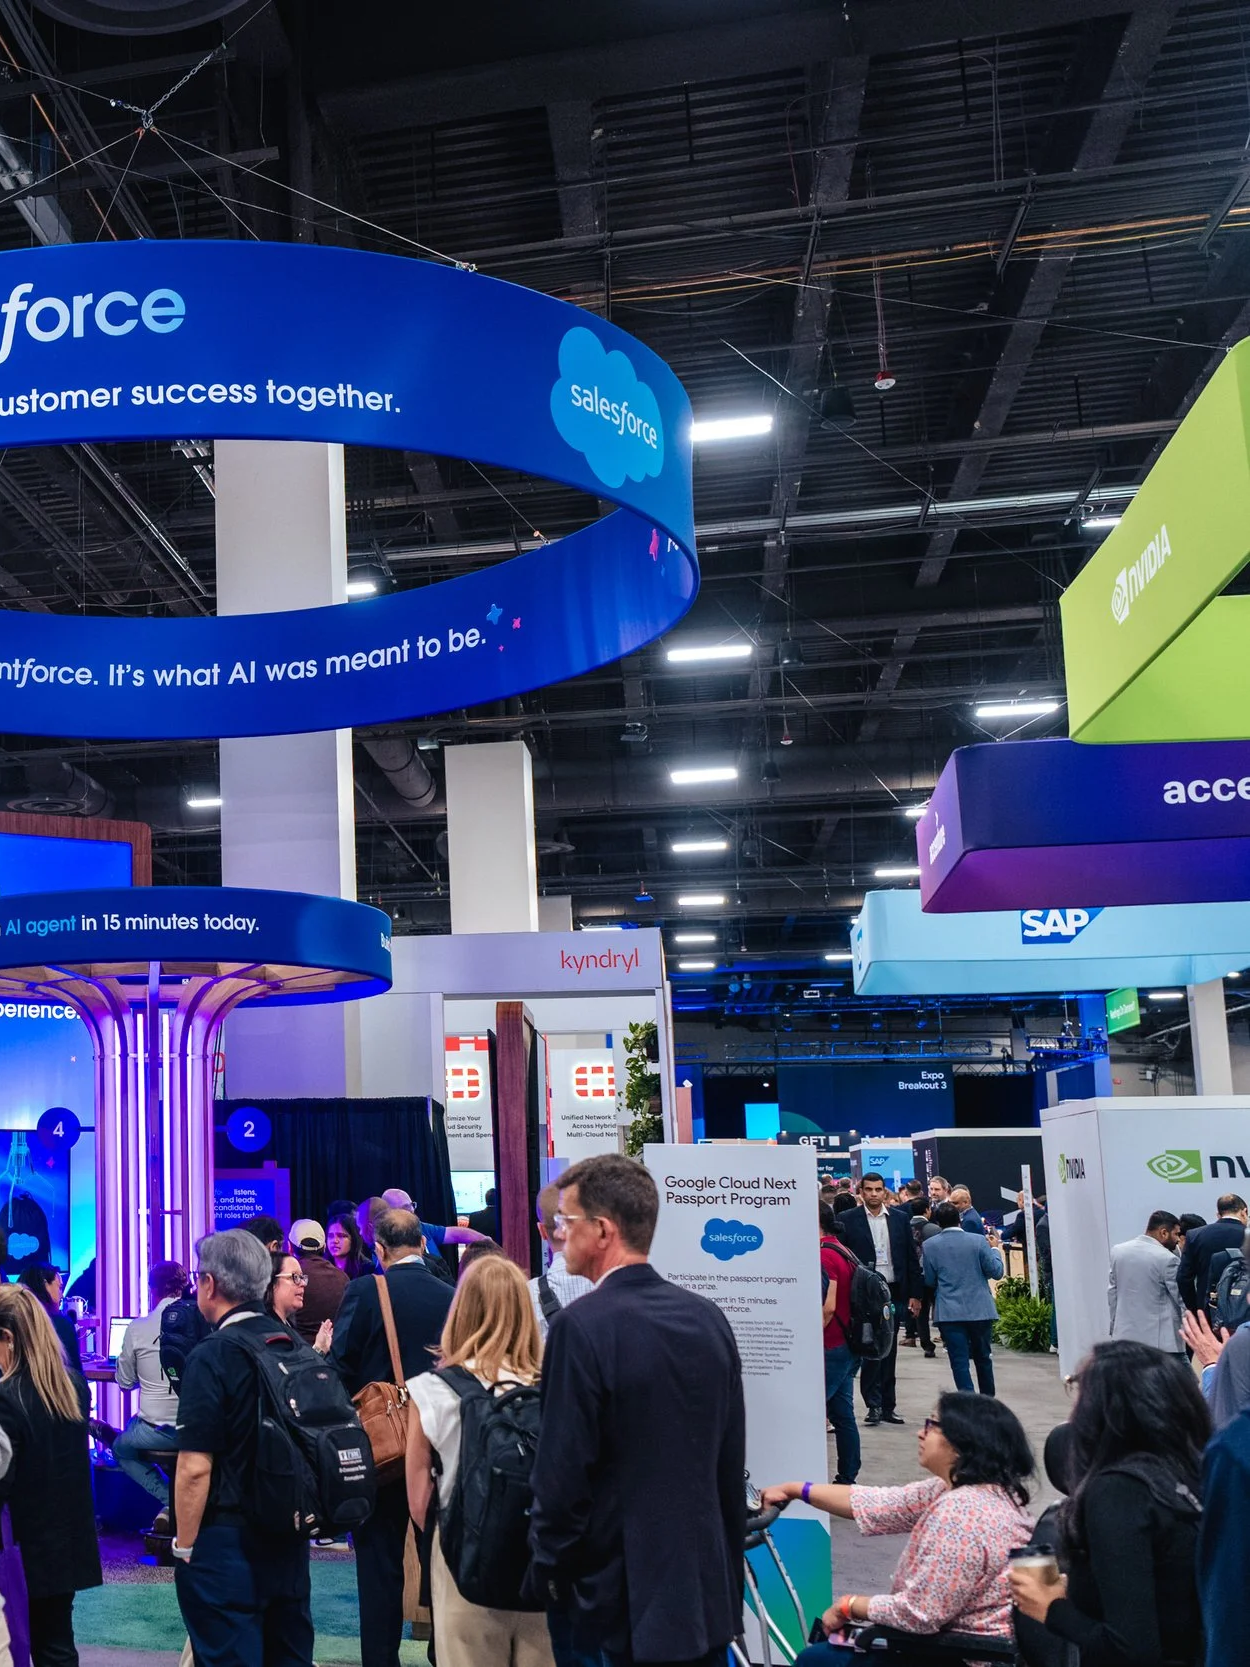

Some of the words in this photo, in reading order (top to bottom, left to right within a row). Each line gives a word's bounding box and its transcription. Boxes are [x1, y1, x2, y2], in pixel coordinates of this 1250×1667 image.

[131, 379, 257, 406] success
[266, 377, 402, 414] together.
[570, 382, 658, 450] salesforce
[108, 663, 145, 687] It's
[153, 661, 221, 687] what
[228, 660, 256, 686] AI
[265, 658, 317, 682] was
[326, 642, 410, 675] meant
[417, 634, 442, 659] to
[448, 626, 487, 655] be.
[5, 919, 21, 936] AI
[26, 915, 77, 937] agent
[81, 915, 97, 931] in
[102, 914, 121, 931] 15
[125, 913, 199, 931] minutes
[204, 913, 260, 934] today.
[1021, 908, 1090, 937] SAP
[560, 948, 641, 975] kyndryl
[921, 1071, 945, 1081] Expo
[898, 1081, 940, 1090] Breakout
[941, 1081, 948, 1090] 3
[52, 1120, 65, 1138] 4
[243, 1121, 256, 1138] 2
[799, 1136, 827, 1147] GFT
[869, 1157, 885, 1166] SAP
[1066, 1158, 1086, 1179] NVIDIA
[664, 1176, 716, 1191] Google
[719, 1176, 762, 1190] Cloud
[764, 1177, 797, 1190] Next
[666, 1191, 727, 1208] Passport
[730, 1193, 791, 1208] Program
[708, 1232, 758, 1245] salesforce
[668, 1273, 707, 1283] Participate
[730, 1275, 764, 1284] passport
[764, 1276, 798, 1285] program
[698, 1283, 718, 1291] prize.
[746, 1297, 778, 1305] minutes
